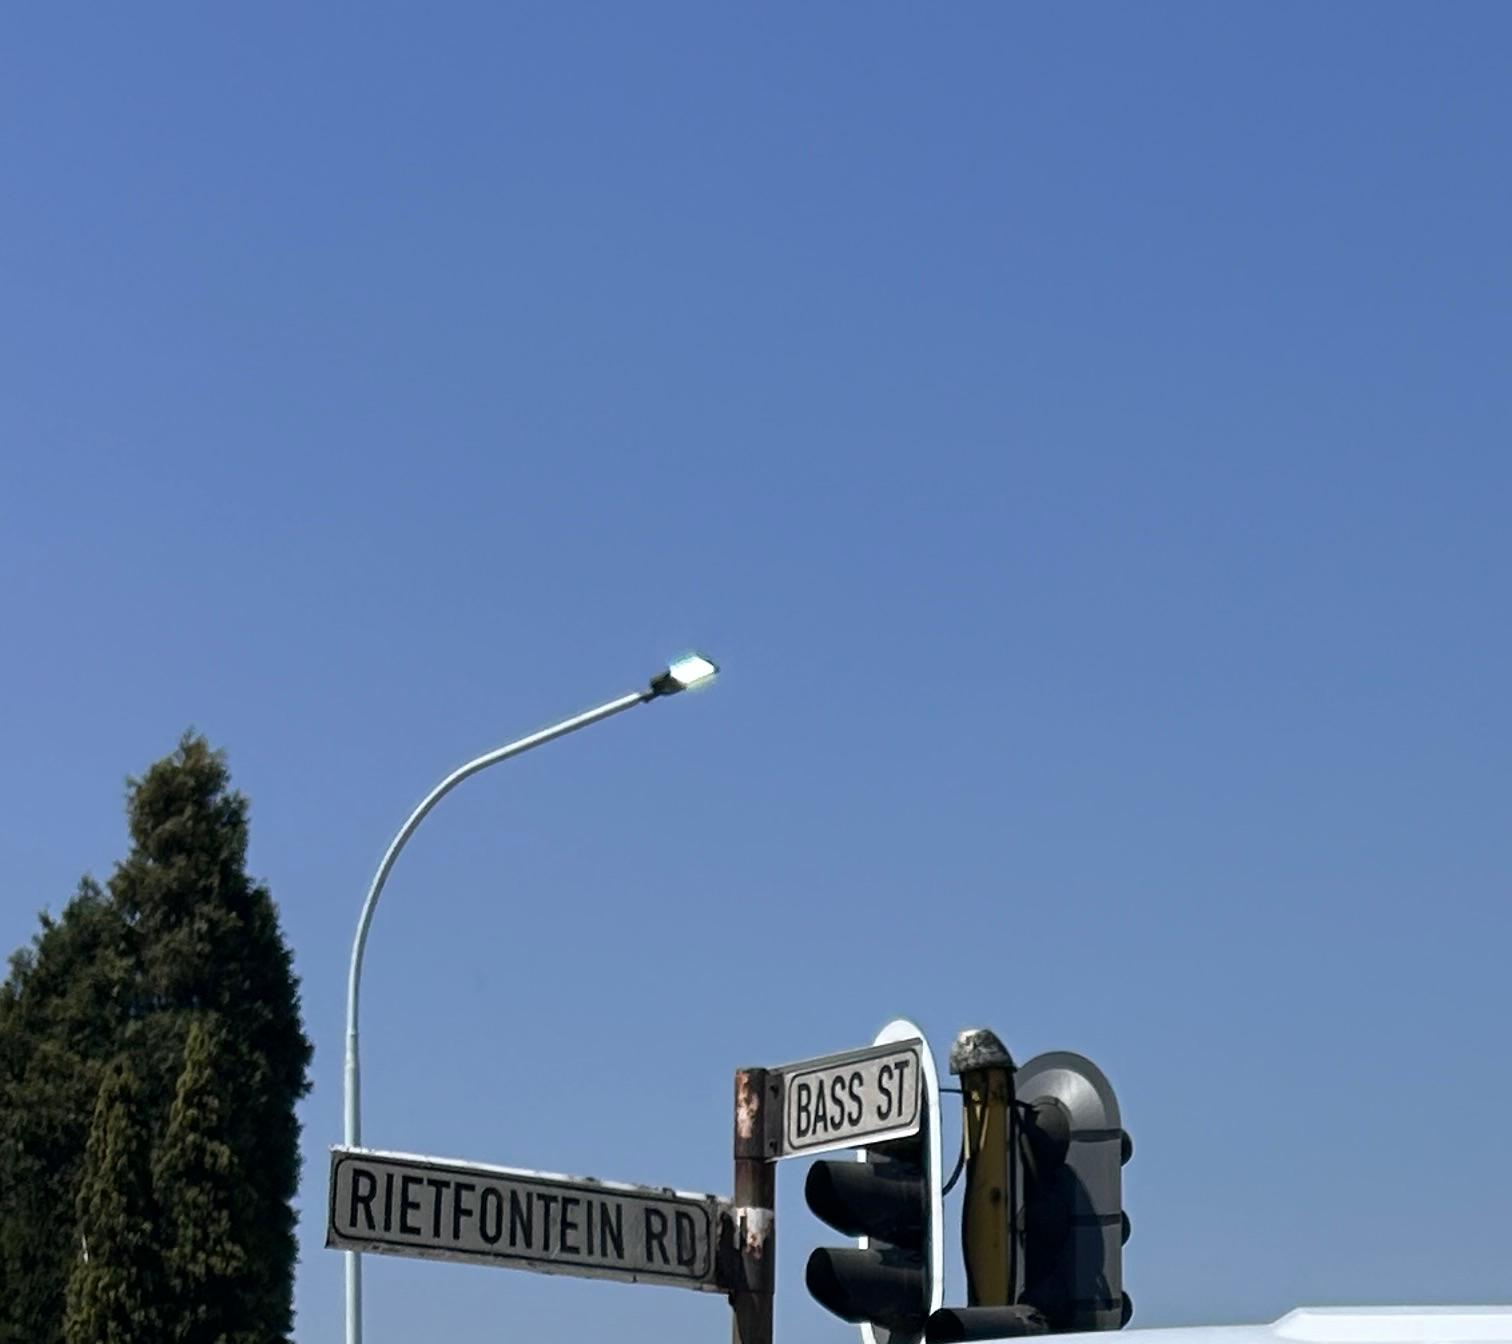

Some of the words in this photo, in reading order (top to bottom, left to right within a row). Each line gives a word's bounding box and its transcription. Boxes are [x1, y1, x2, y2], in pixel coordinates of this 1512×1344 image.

[796, 1071, 863, 1139] BASS
[877, 1059, 910, 1121] ST
[349, 1168, 625, 1260] RIETFONTEIN
[644, 1207, 696, 1267] RD
